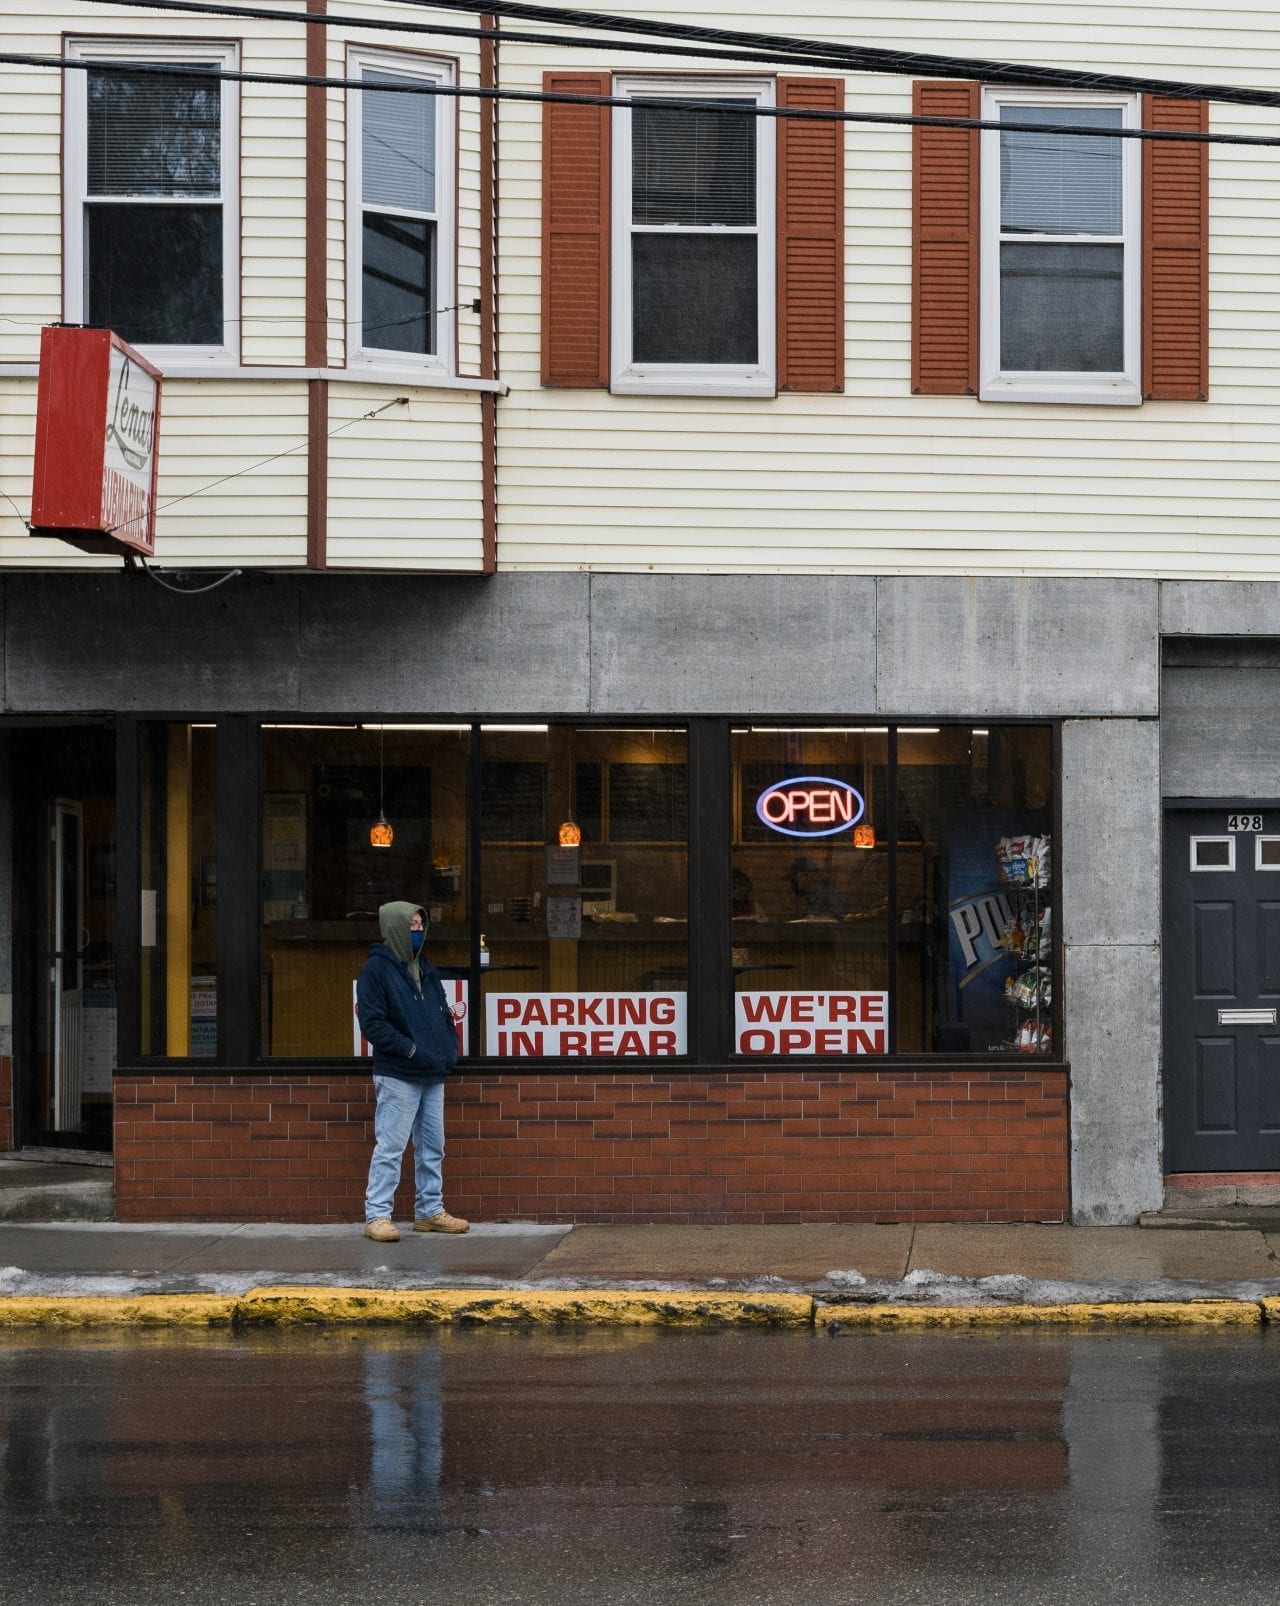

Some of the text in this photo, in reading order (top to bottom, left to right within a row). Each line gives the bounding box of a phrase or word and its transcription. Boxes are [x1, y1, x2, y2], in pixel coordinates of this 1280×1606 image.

[762, 789, 852, 823] OPEN
[1228, 815, 1262, 831] 498
[497, 998, 675, 1025] PARKING
[741, 995, 883, 1022] WE'RE
[498, 1031, 676, 1056] IN REAR
[739, 1030, 884, 1054] OPEN
